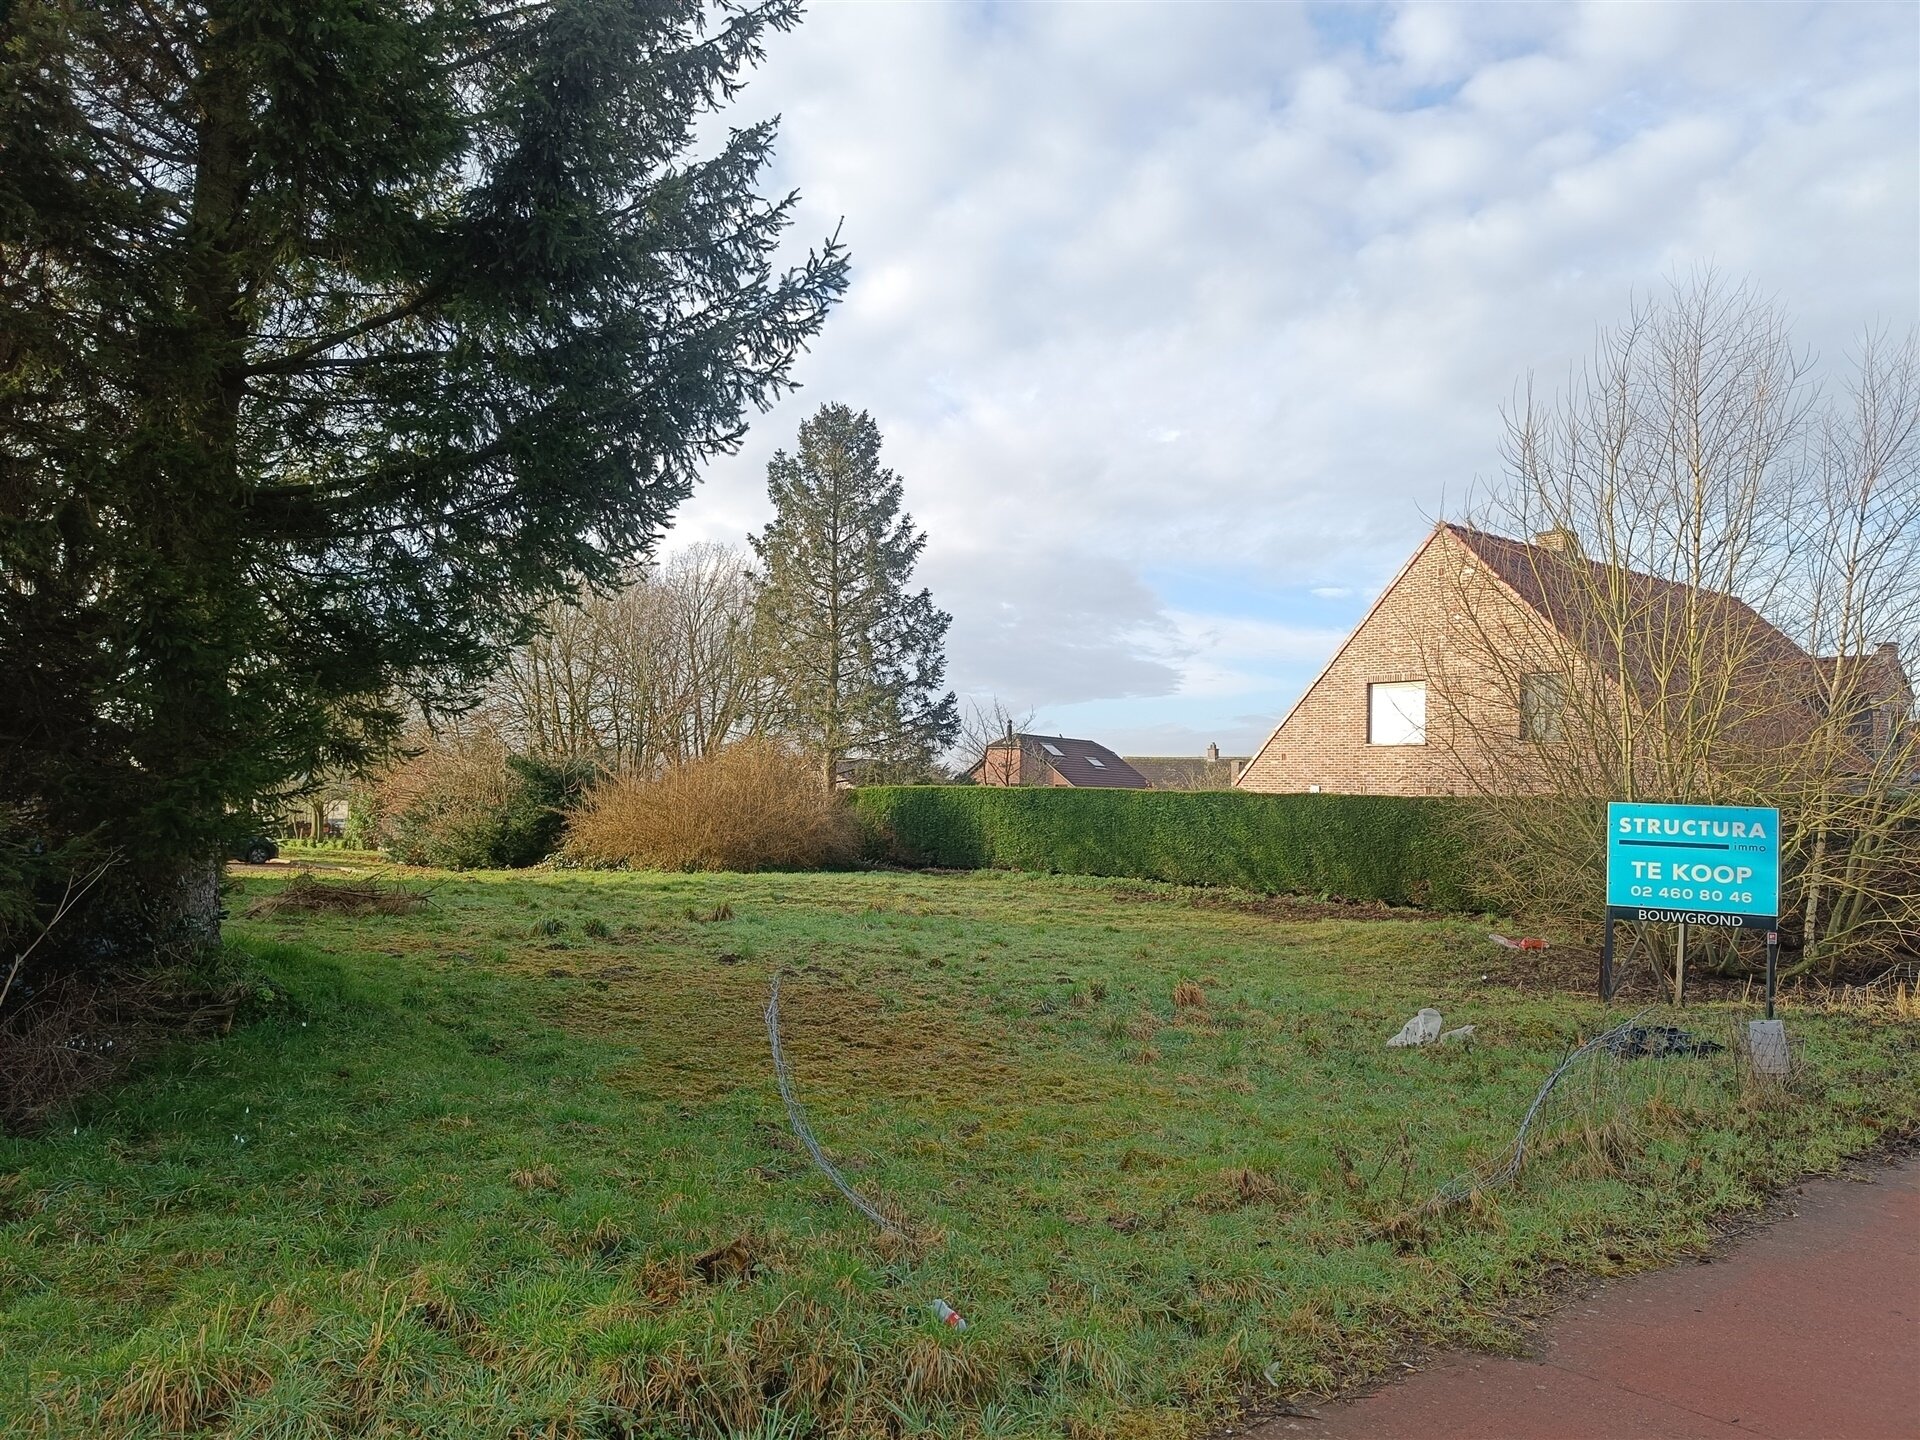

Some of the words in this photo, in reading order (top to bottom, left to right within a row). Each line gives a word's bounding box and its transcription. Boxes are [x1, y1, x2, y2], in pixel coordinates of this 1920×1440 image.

[1619, 817, 1766, 839] STRUCTURA
[1734, 842, 1766, 852] immo
[1631, 861, 1662, 880] TE
[1672, 863, 1753, 884] KOOP
[1630, 885, 1653, 897] 02
[1658, 887, 1693, 900] 460
[1699, 889, 1723, 901] 80
[1729, 891, 1753, 904] 46
[1638, 909, 1743, 927] BOUWGROND
